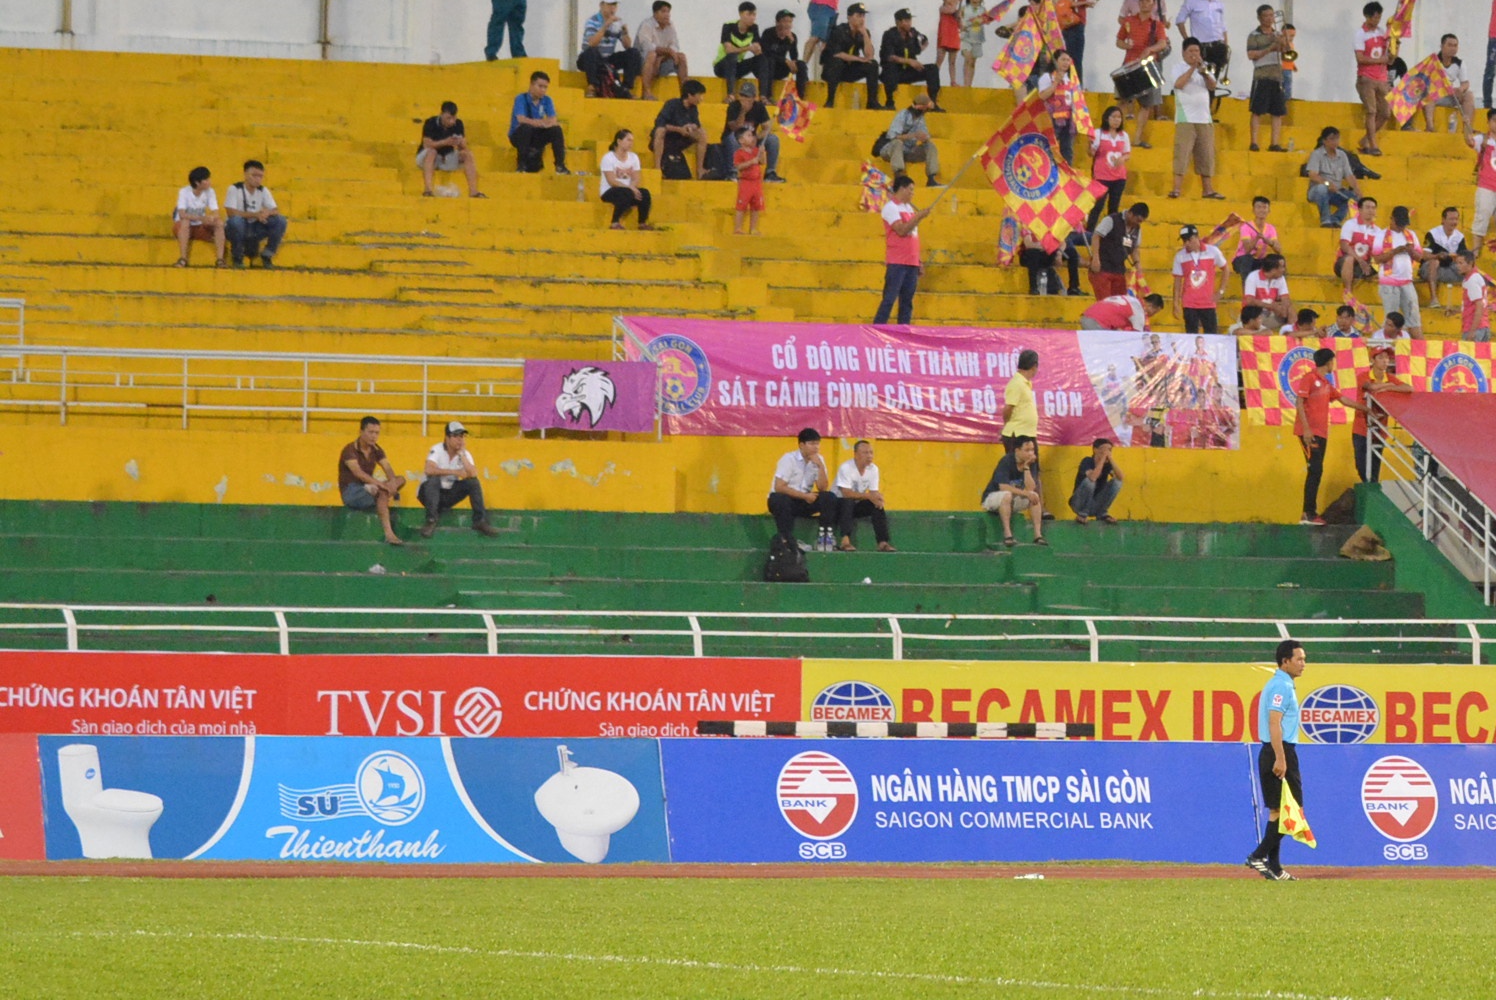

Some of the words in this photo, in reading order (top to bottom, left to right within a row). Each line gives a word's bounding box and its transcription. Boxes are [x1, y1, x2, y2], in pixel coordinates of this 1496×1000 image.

[771, 335, 798, 369] CỔ
[806, 341, 861, 376] ĐỘNG
[865, 343, 912, 375] VIÊN
[917, 346, 980, 378] THÀNH
[718, 375, 758, 407] SÁT
[765, 375, 821, 407] CÁNH
[827, 377, 879, 409] CÙNG
[884, 380, 925, 411] CÂU
[929, 386, 966, 418] LẠC
[971, 384, 997, 420] BỘ
[1043, 386, 1084, 417] GÒN
[80, 684, 160, 709] KHOÁN
[163, 685, 205, 709] TÂN
[209, 685, 258, 714] VIỆT
[524, 687, 601, 712] CHỨNG
[606, 689, 682, 712] KHOÁN
[686, 689, 727, 712] TÂN
[728, 690, 775, 717] VIỆT
[317, 689, 447, 737] TVSI
[813, 706, 892, 721] BECAMEX
[902, 688, 1172, 741] BECAMEX
[1301, 710, 1377, 724] BECAMEX
[71, 719, 98, 735] Sàn
[102, 720, 134, 735] giao
[170, 719, 195, 735] của
[229, 720, 257, 735] nhà
[599, 722, 625, 737] Sàn
[627, 723, 658, 737] giao
[871, 768, 932, 803] NGÂN
[938, 768, 997, 803] HÀNG
[1002, 775, 1061, 803] TMCP
[1066, 769, 1101, 803] SÀI
[1105, 769, 1151, 804] GÒN
[781, 799, 828, 808] BANK
[1366, 802, 1409, 811] BANK
[875, 811, 953, 829] SAIGON
[959, 811, 1095, 829] COMMERCIAL
[1100, 812, 1154, 829] BANK
[265, 825, 447, 860] Thienthanh
[800, 843, 847, 859] SCB
[1384, 844, 1428, 860] SCB
